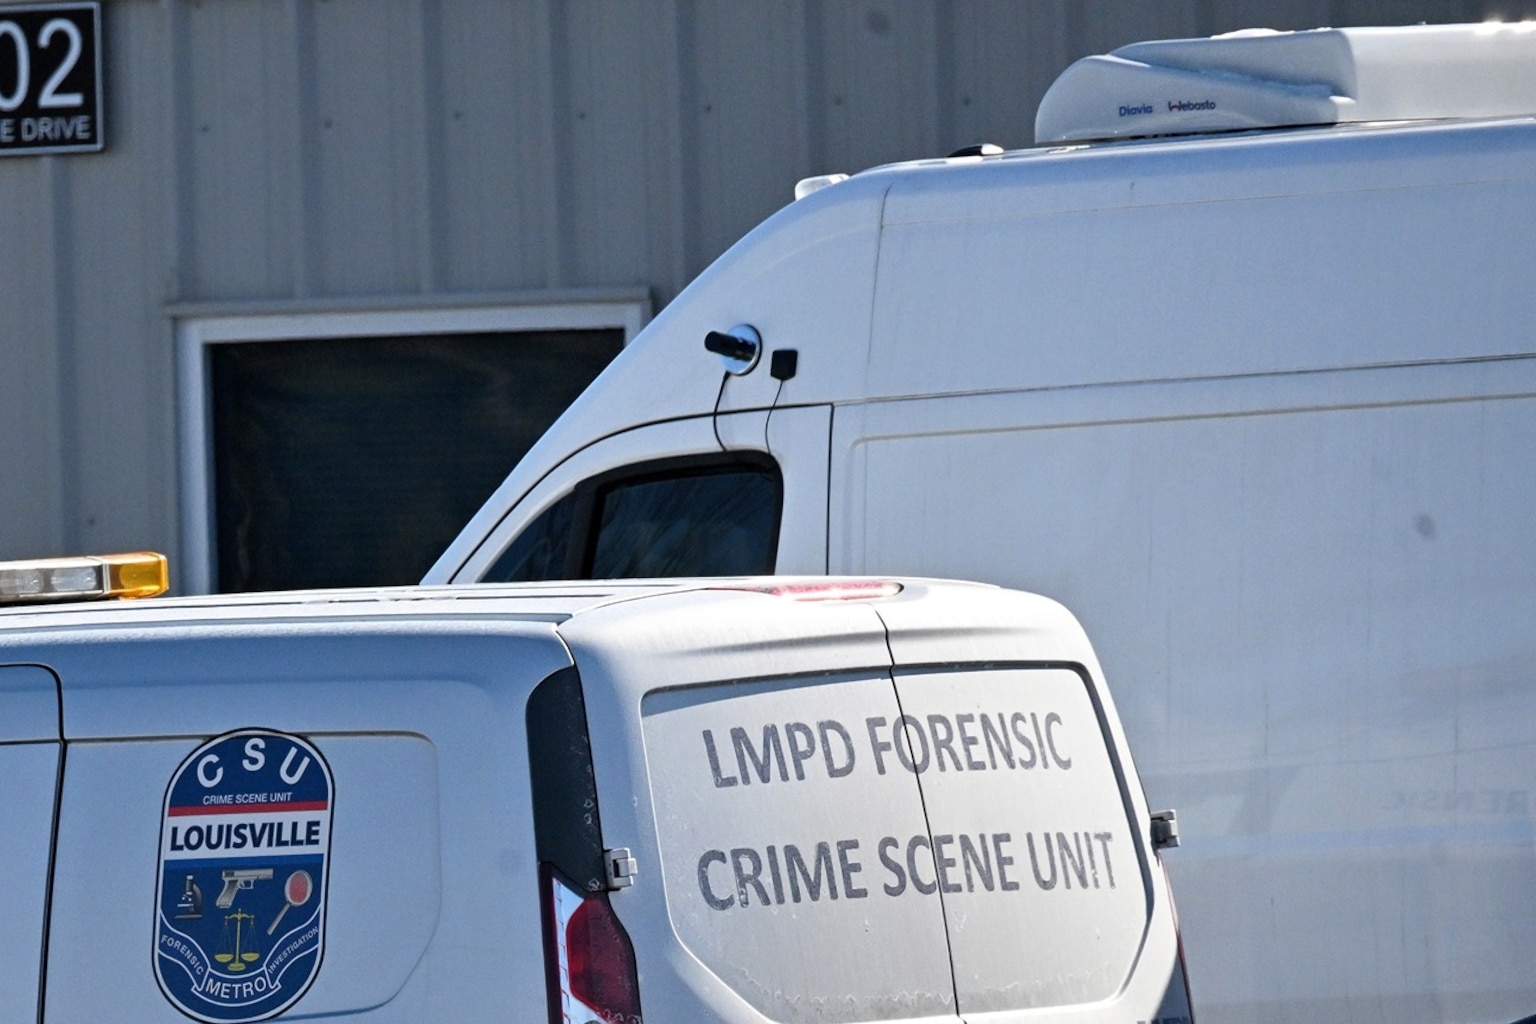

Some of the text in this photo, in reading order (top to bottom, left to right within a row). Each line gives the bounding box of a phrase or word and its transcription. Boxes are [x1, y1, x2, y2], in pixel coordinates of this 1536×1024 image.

[1119, 100, 1216, 117] Diavia Webasto
[21, 116, 91, 142] DRIVE
[702, 712, 1072, 788] LMPD FORENSIC
[203, 792, 293, 805] CRIME SCENE UNIT
[170, 821, 321, 851] LOUISVILLE
[696, 832, 1116, 911] CRIME SCENE UNIT
[161, 935, 203, 976] FORENSIC
[268, 925, 320, 974] INVESTIGATION
[205, 977, 267, 999] METRO
